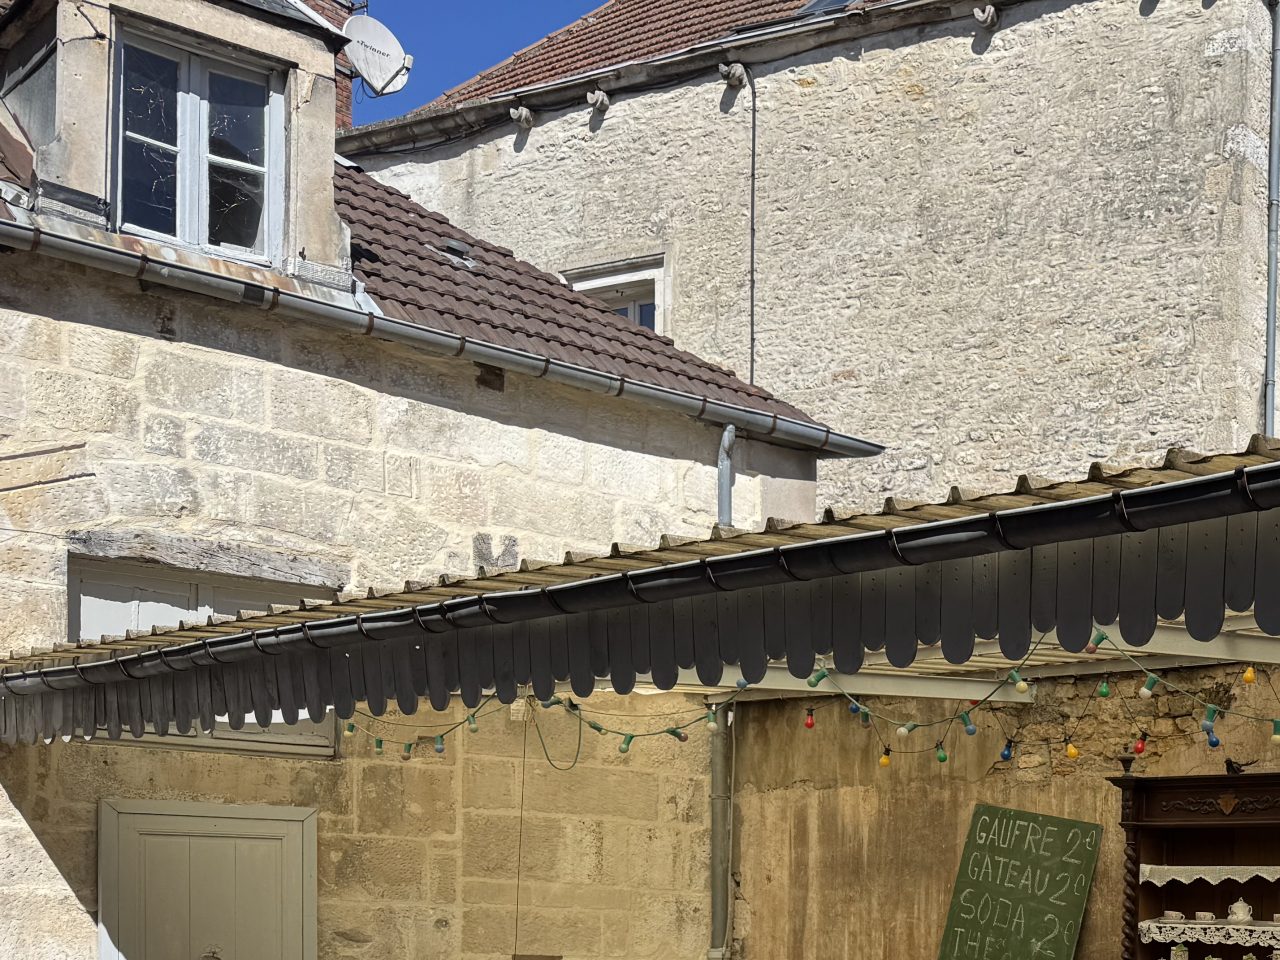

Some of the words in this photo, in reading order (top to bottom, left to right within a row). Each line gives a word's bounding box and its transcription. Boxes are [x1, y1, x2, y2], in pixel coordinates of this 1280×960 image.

[976, 815, 1058, 856] GAUFRE
[968, 851, 1050, 896] GATEAU
[960, 888, 1025, 938] SODA
